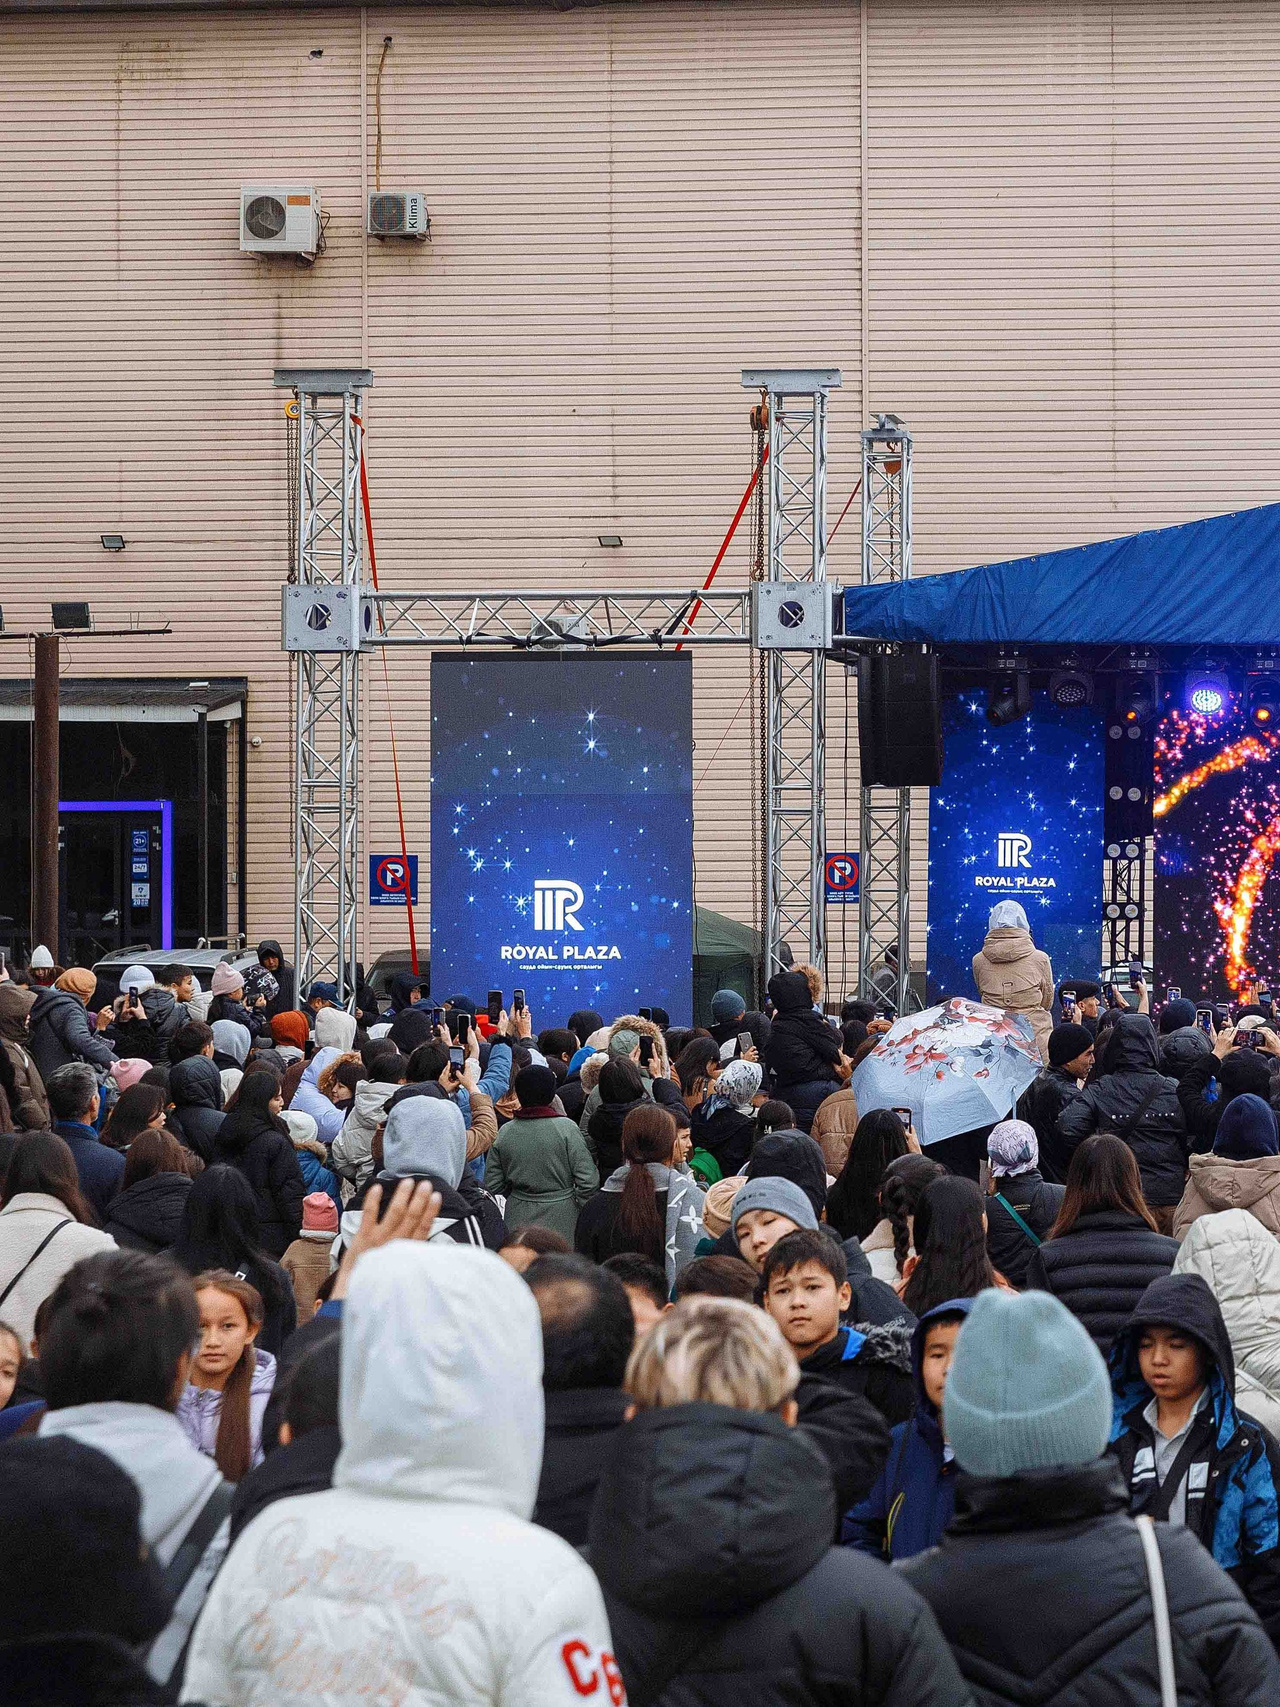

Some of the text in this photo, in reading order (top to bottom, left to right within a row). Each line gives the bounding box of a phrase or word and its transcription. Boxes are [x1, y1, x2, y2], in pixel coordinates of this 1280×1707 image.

[408, 197, 418, 229] Klima
[975, 876, 1056, 887] ROYAL PLAZA
[501, 945, 621, 960] ROYAL PLAZA
